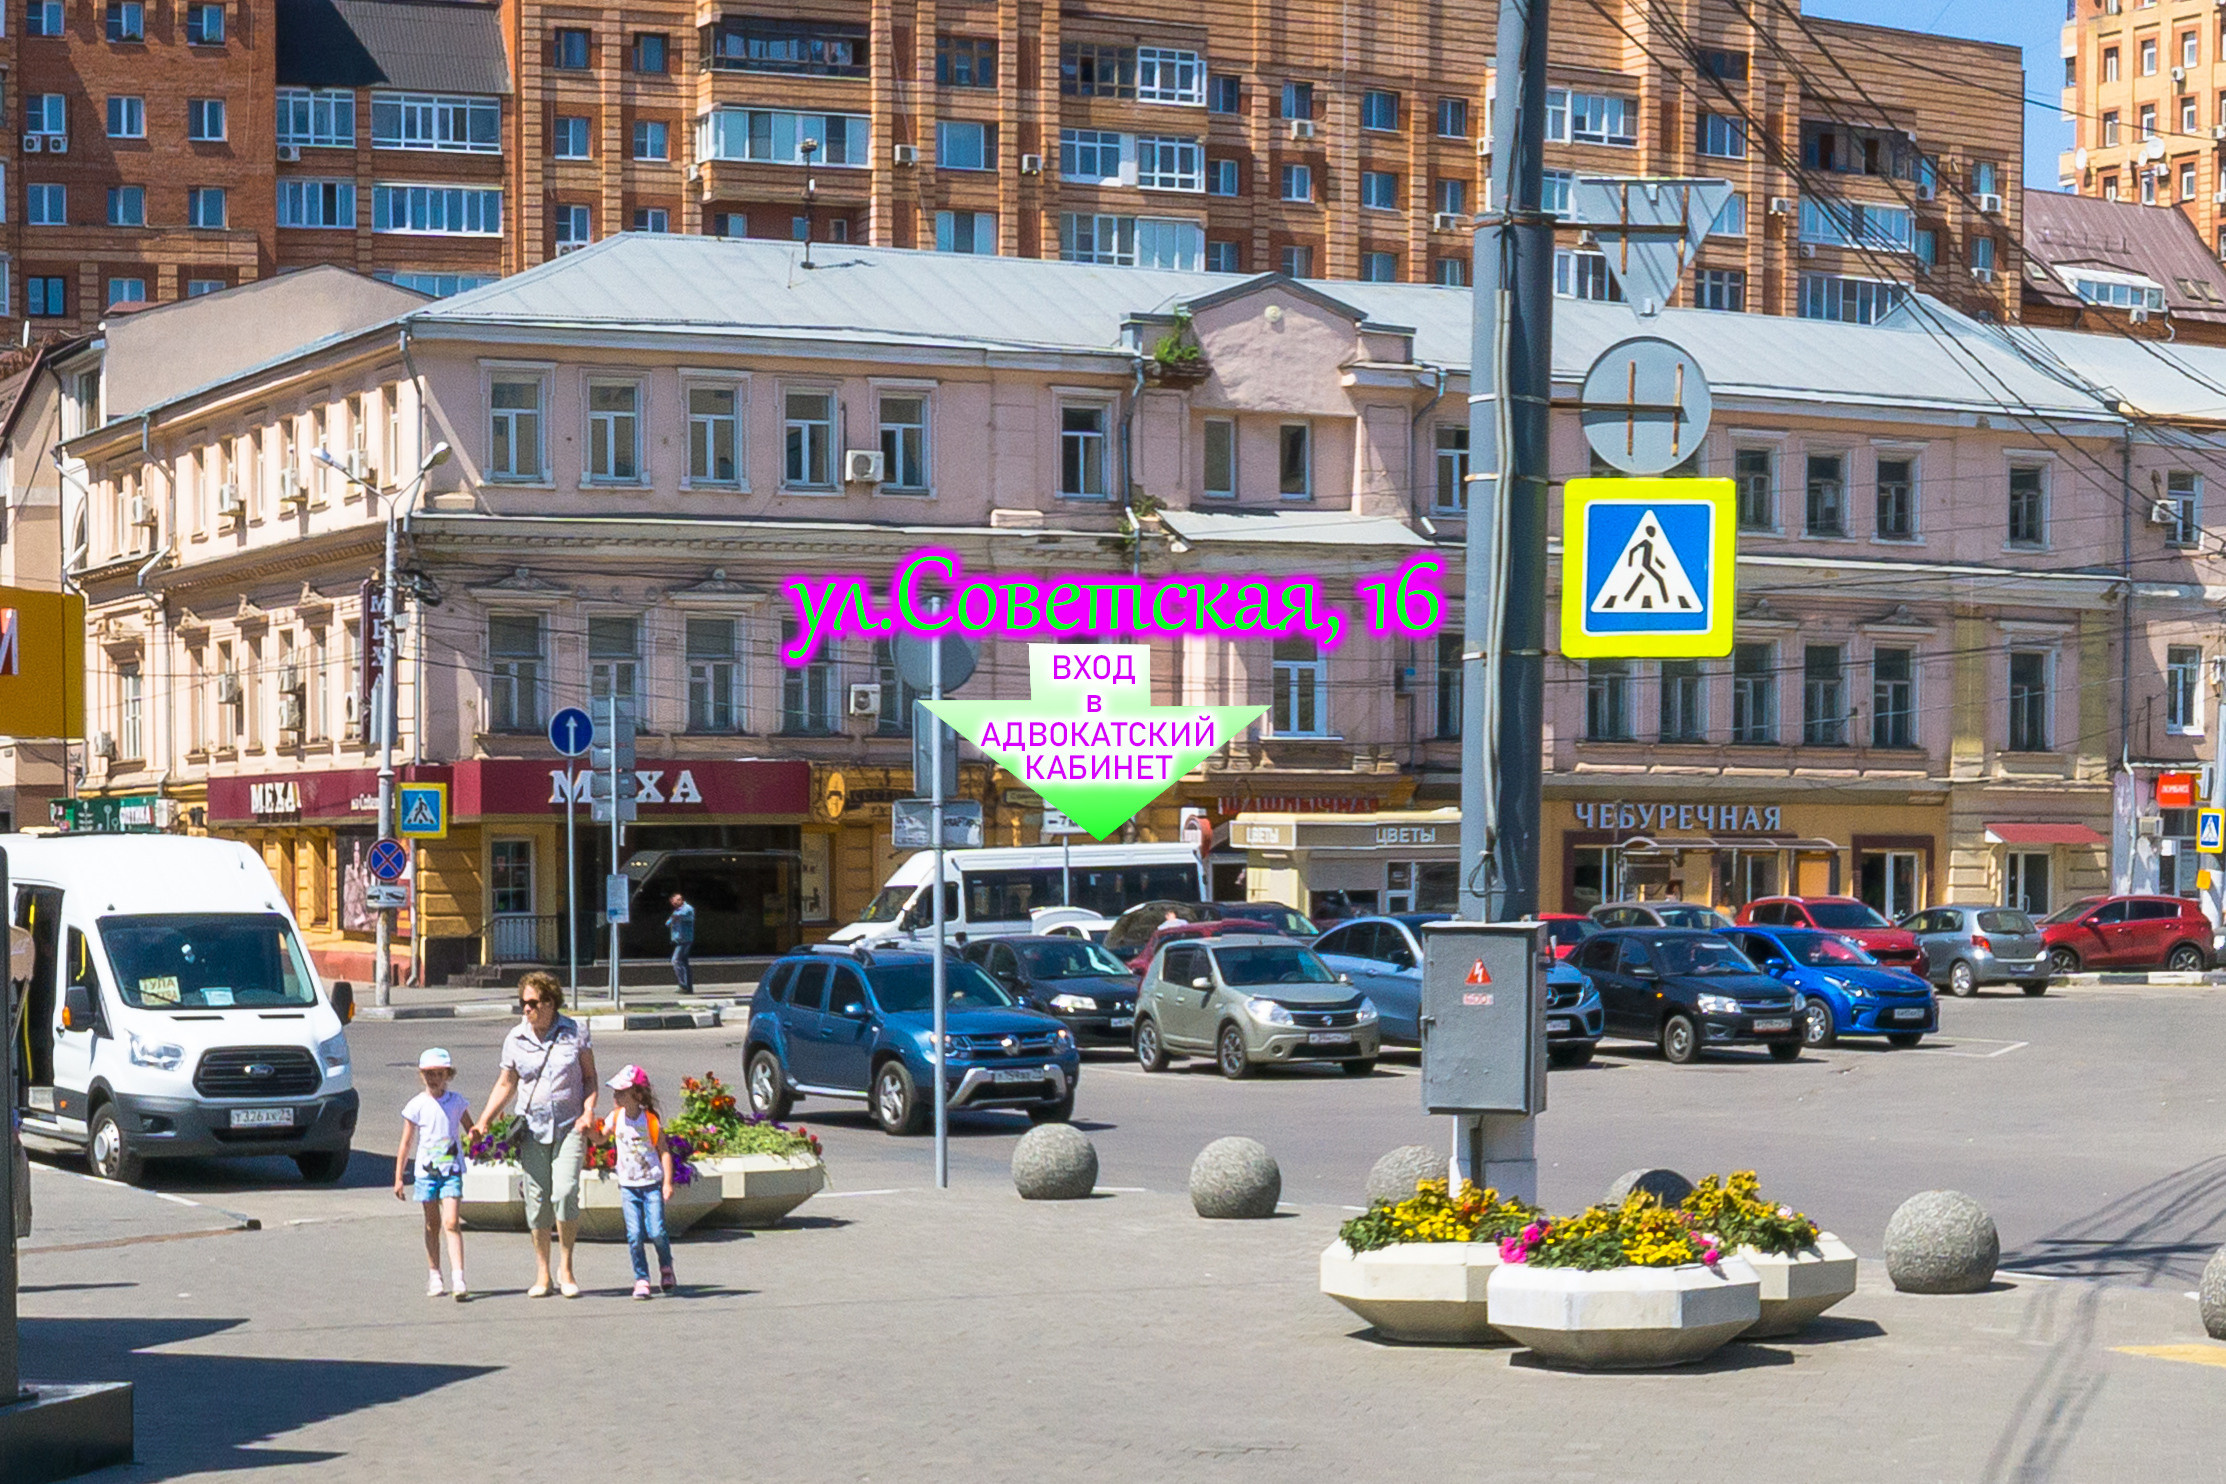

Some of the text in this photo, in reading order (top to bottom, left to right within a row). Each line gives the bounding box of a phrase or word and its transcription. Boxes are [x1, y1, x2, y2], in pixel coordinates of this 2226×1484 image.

[250, 781, 302, 814] МЕХА
[548, 770, 702, 803] МХА
[1576, 803, 1781, 831] ЧЕБУРЕЧНАЯ
[1246, 827, 1279, 843] ЦВЕТЫ
[1376, 827, 1436, 845] ЦВЕТЫ
